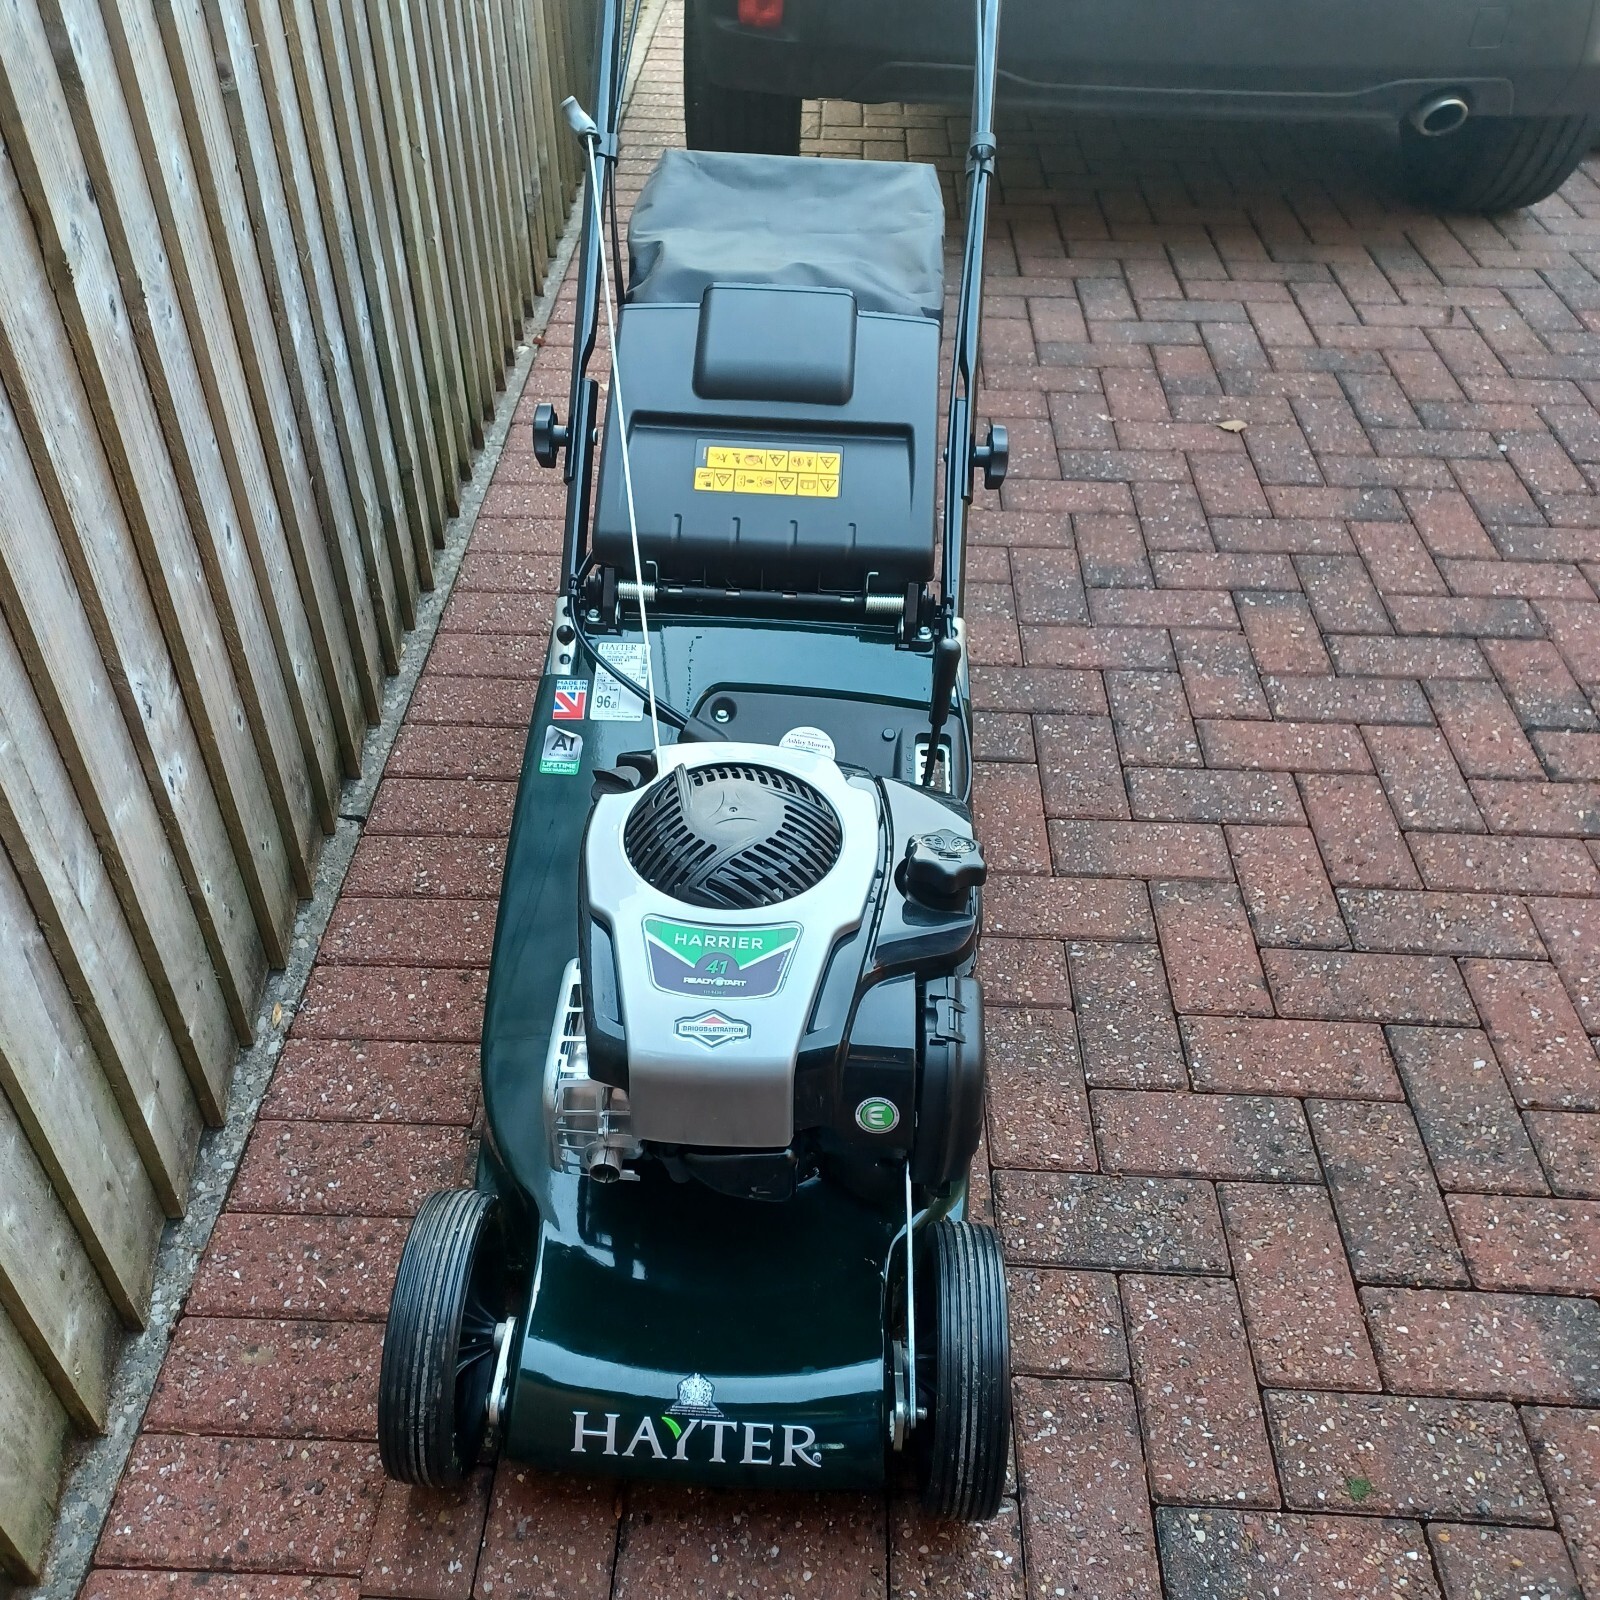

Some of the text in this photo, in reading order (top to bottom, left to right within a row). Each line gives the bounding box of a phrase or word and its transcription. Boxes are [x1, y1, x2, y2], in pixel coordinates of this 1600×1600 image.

[601, 643, 638, 652] HAYTER
[596, 695, 611, 709] 96
[786, 738, 807, 747] Ashley
[807, 740, 831, 750] Mowers
[541, 761, 577, 769] LIFETIME
[674, 932, 764, 950] HARRIER
[705, 959, 729, 975] 41
[570, 1410, 822, 1468] HAYTER
